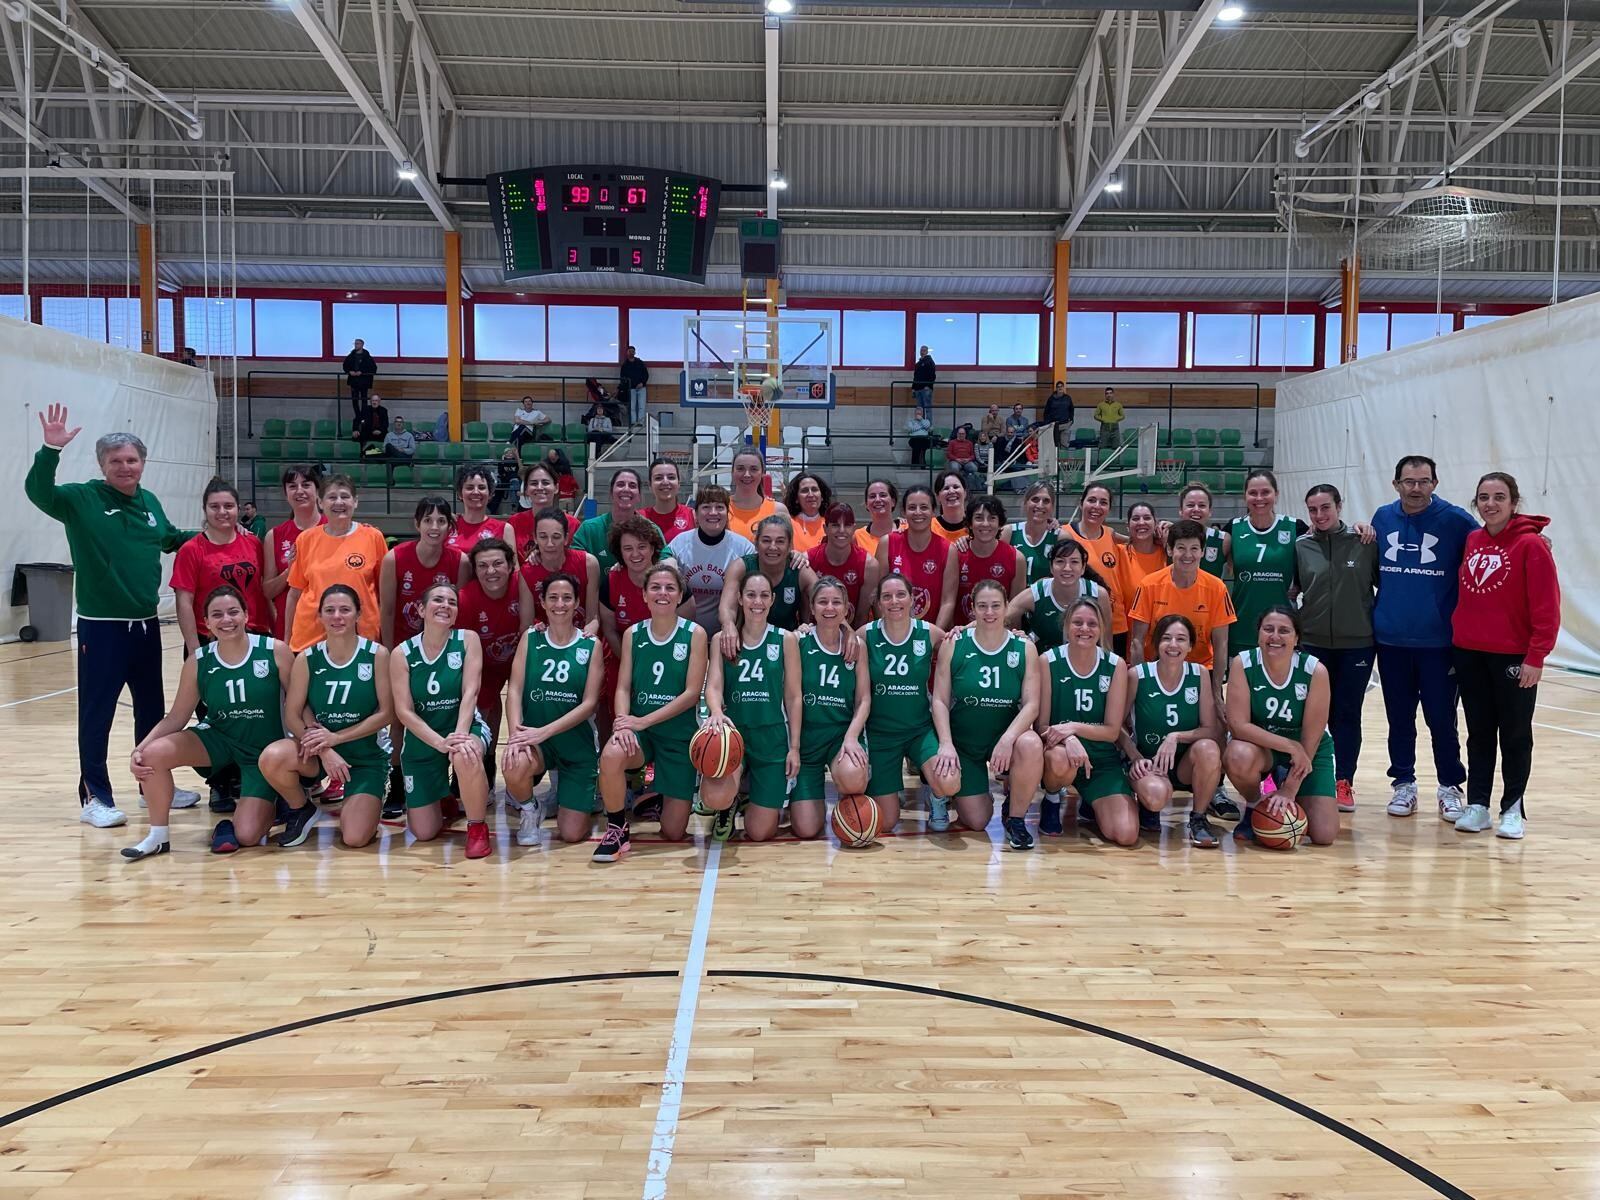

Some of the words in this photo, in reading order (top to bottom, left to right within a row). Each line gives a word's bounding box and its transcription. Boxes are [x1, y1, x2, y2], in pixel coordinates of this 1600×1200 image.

[571, 186, 589, 203] 93
[600, 188, 608, 202] 0
[628, 188, 646, 204] 67
[569, 250, 577, 263] 3
[633, 251, 640, 264] 5
[1256, 544, 1267, 562] 7
[1470, 558, 1498, 569] UBB
[223, 566, 254, 580] UBB
[1404, 568, 1444, 576] ARMOUR
[541, 659, 570, 683] 28
[652, 661, 664, 685] 9
[738, 659, 764, 682] 24
[819, 664, 840, 688] 14
[884, 654, 909, 676] 26
[427, 672, 440, 694] 6
[978, 666, 1000, 688] 31
[225, 678, 246, 703] 11
[325, 681, 352, 704] 77
[427, 697, 459, 706] ARAGONIA
[545, 690, 577, 699] ARAGONIA
[1074, 689, 1093, 712] 15
[1166, 704, 1178, 726] 5
[1266, 697, 1293, 721] 94
